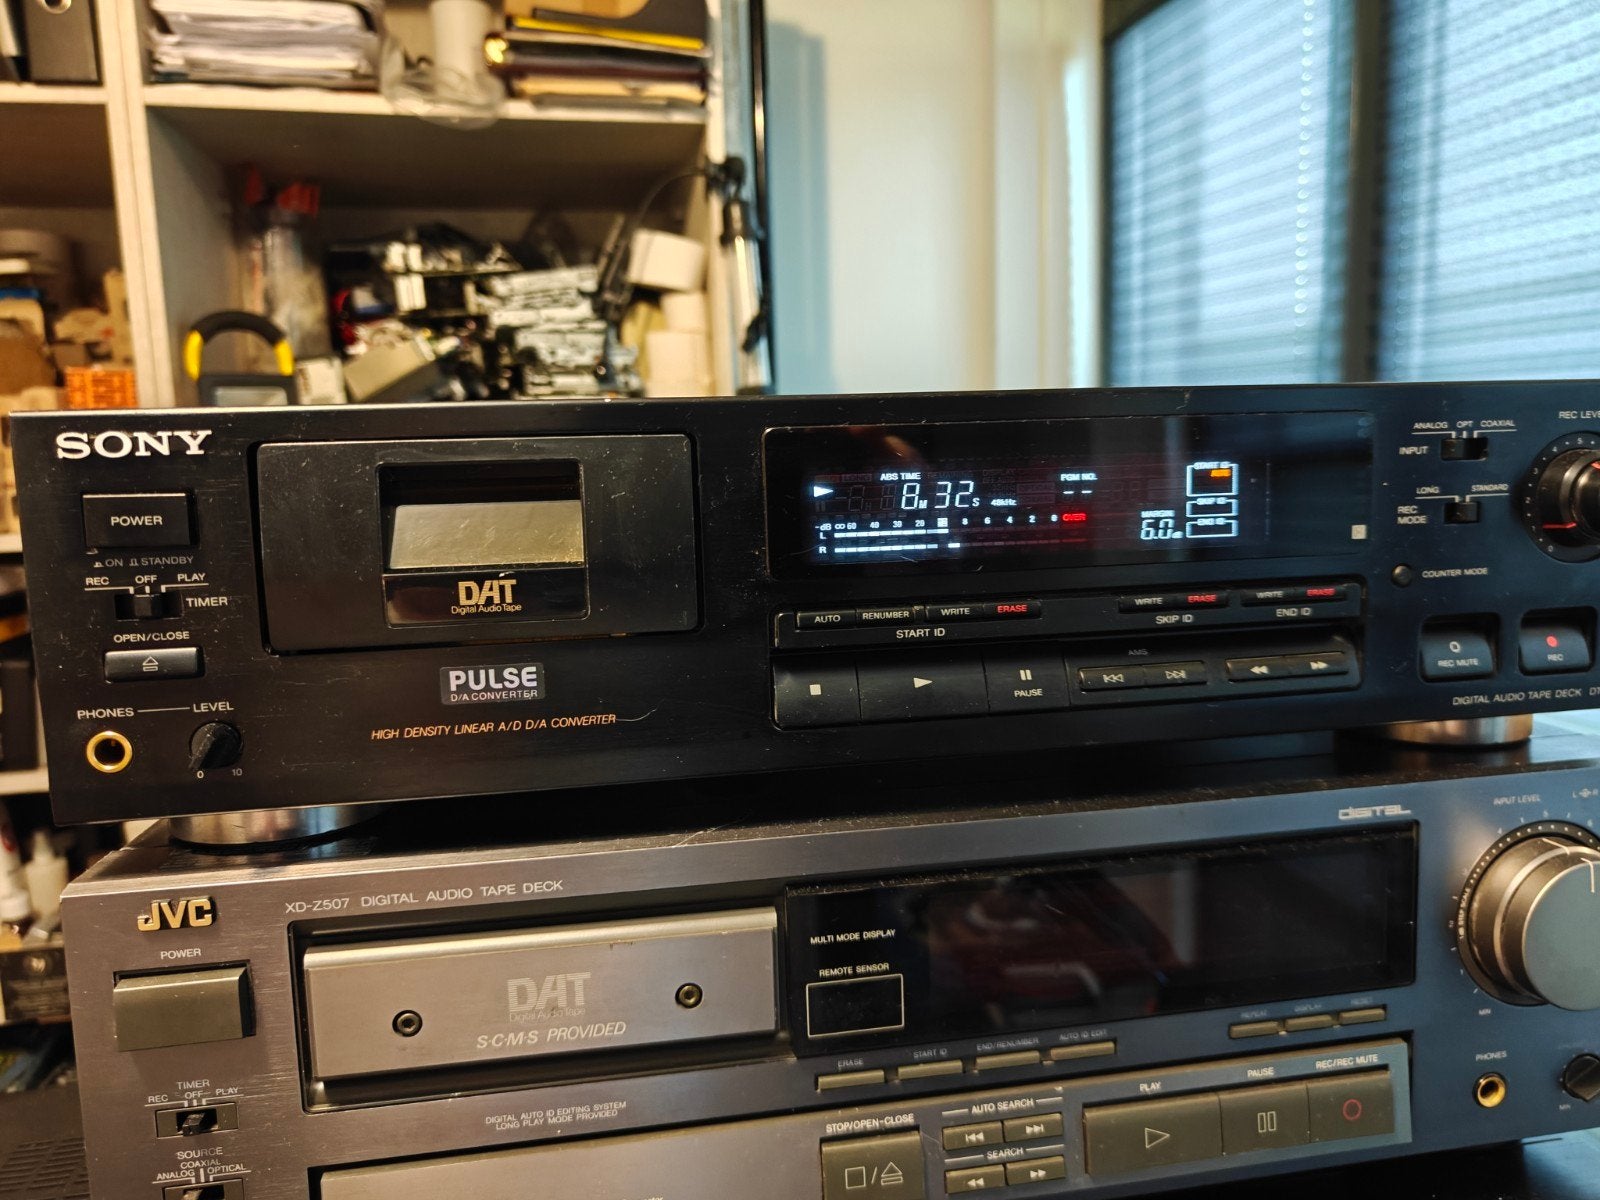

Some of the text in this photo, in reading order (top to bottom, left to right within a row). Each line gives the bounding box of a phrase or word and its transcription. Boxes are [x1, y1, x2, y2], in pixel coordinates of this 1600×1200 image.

[1559, 411, 1577, 419] REC
[1413, 419, 1516, 430] ANALOG OPT COAXIAL
[55, 430, 212, 459] SONY
[1399, 446, 1429, 455] INPUT
[880, 473, 899, 481] ABS
[900, 472, 921, 480] TIME
[1416, 484, 1509, 494] LONG STANDARD
[1397, 505, 1418, 514] REC
[111, 515, 163, 526] POWER
[984, 517, 991, 525] 6
[1006, 516, 1014, 524] 4
[1029, 515, 1036, 523] 2
[1397, 516, 1427, 525] MODE
[819, 532, 827, 540] L
[819, 546, 827, 554] R
[105, 555, 194, 568] ON STANDBY
[85, 572, 206, 586] REC OFF PLAY
[1421, 567, 1489, 579] COUNTER MODE
[457, 579, 517, 606] DAT
[1256, 588, 1336, 600] WRITE ERASE
[186, 596, 229, 608] TIMER
[1135, 594, 1217, 606] WRITE ERASE
[450, 602, 522, 615] Digital Audio Tape
[940, 603, 1028, 616] WRITE ERASE
[1276, 607, 1312, 618] END ID
[814, 610, 910, 623] AUTO RENUMBER
[1155, 613, 1194, 625] SKIP ID
[113, 630, 191, 643] OPEN/CLOSE
[896, 627, 946, 639] START ID
[1437, 658, 1479, 668] REC MUTE
[1547, 653, 1564, 662] REC
[449, 666, 538, 692] PULSE
[450, 690, 538, 702] D/A CONVERTER
[1014, 688, 1043, 698] PAUSE
[1453, 695, 1490, 706] DIGITAL
[1493, 692, 1526, 702] AUDIO
[1528, 690, 1552, 700] TAPE
[1555, 688, 1583, 698] DECK
[76, 701, 235, 720] PHONES LEVEL
[371, 713, 616, 740] HIGH DENSITY LINEAR A/D D/A CONVERTER
[196, 770, 205, 779] 0
[231, 768, 243, 777] 10
[1493, 794, 1541, 805] INPUT LEVEL
[285, 880, 564, 914] XD-Z507 DIGITAL AUDIO TAPE DECK
[137, 898, 213, 932] JVC
[809, 929, 897, 945] MULTI MODE DISPLAY
[160, 948, 202, 960] POWER
[819, 962, 890, 978] REMOTE SENSOR
[507, 972, 592, 1012] DAT
[546, 1021, 627, 1042] PROVIDED
[1058, 1032, 1080, 1042] AUTO
[913, 1048, 947, 1059] START ID
[1475, 1050, 1508, 1061] PHONES
[837, 1058, 864, 1069] ERASE
[1315, 1053, 1379, 1070] REC/REC MUTE
[1247, 1066, 1276, 1078] PAUSE
[177, 1079, 210, 1091] TIMER
[1139, 1081, 1162, 1092] PLAY
[148, 1087, 239, 1104] REC OFF PLAY
[971, 1098, 1035, 1115] AUTO SEARCH
[485, 1101, 628, 1125] DIGITAL AUTO ID EDITING SYSTEM
[495, 1109, 618, 1131] LONG PLAY MODE PROVIDED
[825, 1112, 915, 1134] STOP/OPEN-CLOSE
[176, 1147, 223, 1160] SOURCE
[986, 1147, 1024, 1159] SEARCH
[180, 1159, 221, 1170] COAXIAL
[156, 1164, 247, 1182] ANALOG OPTICAL
